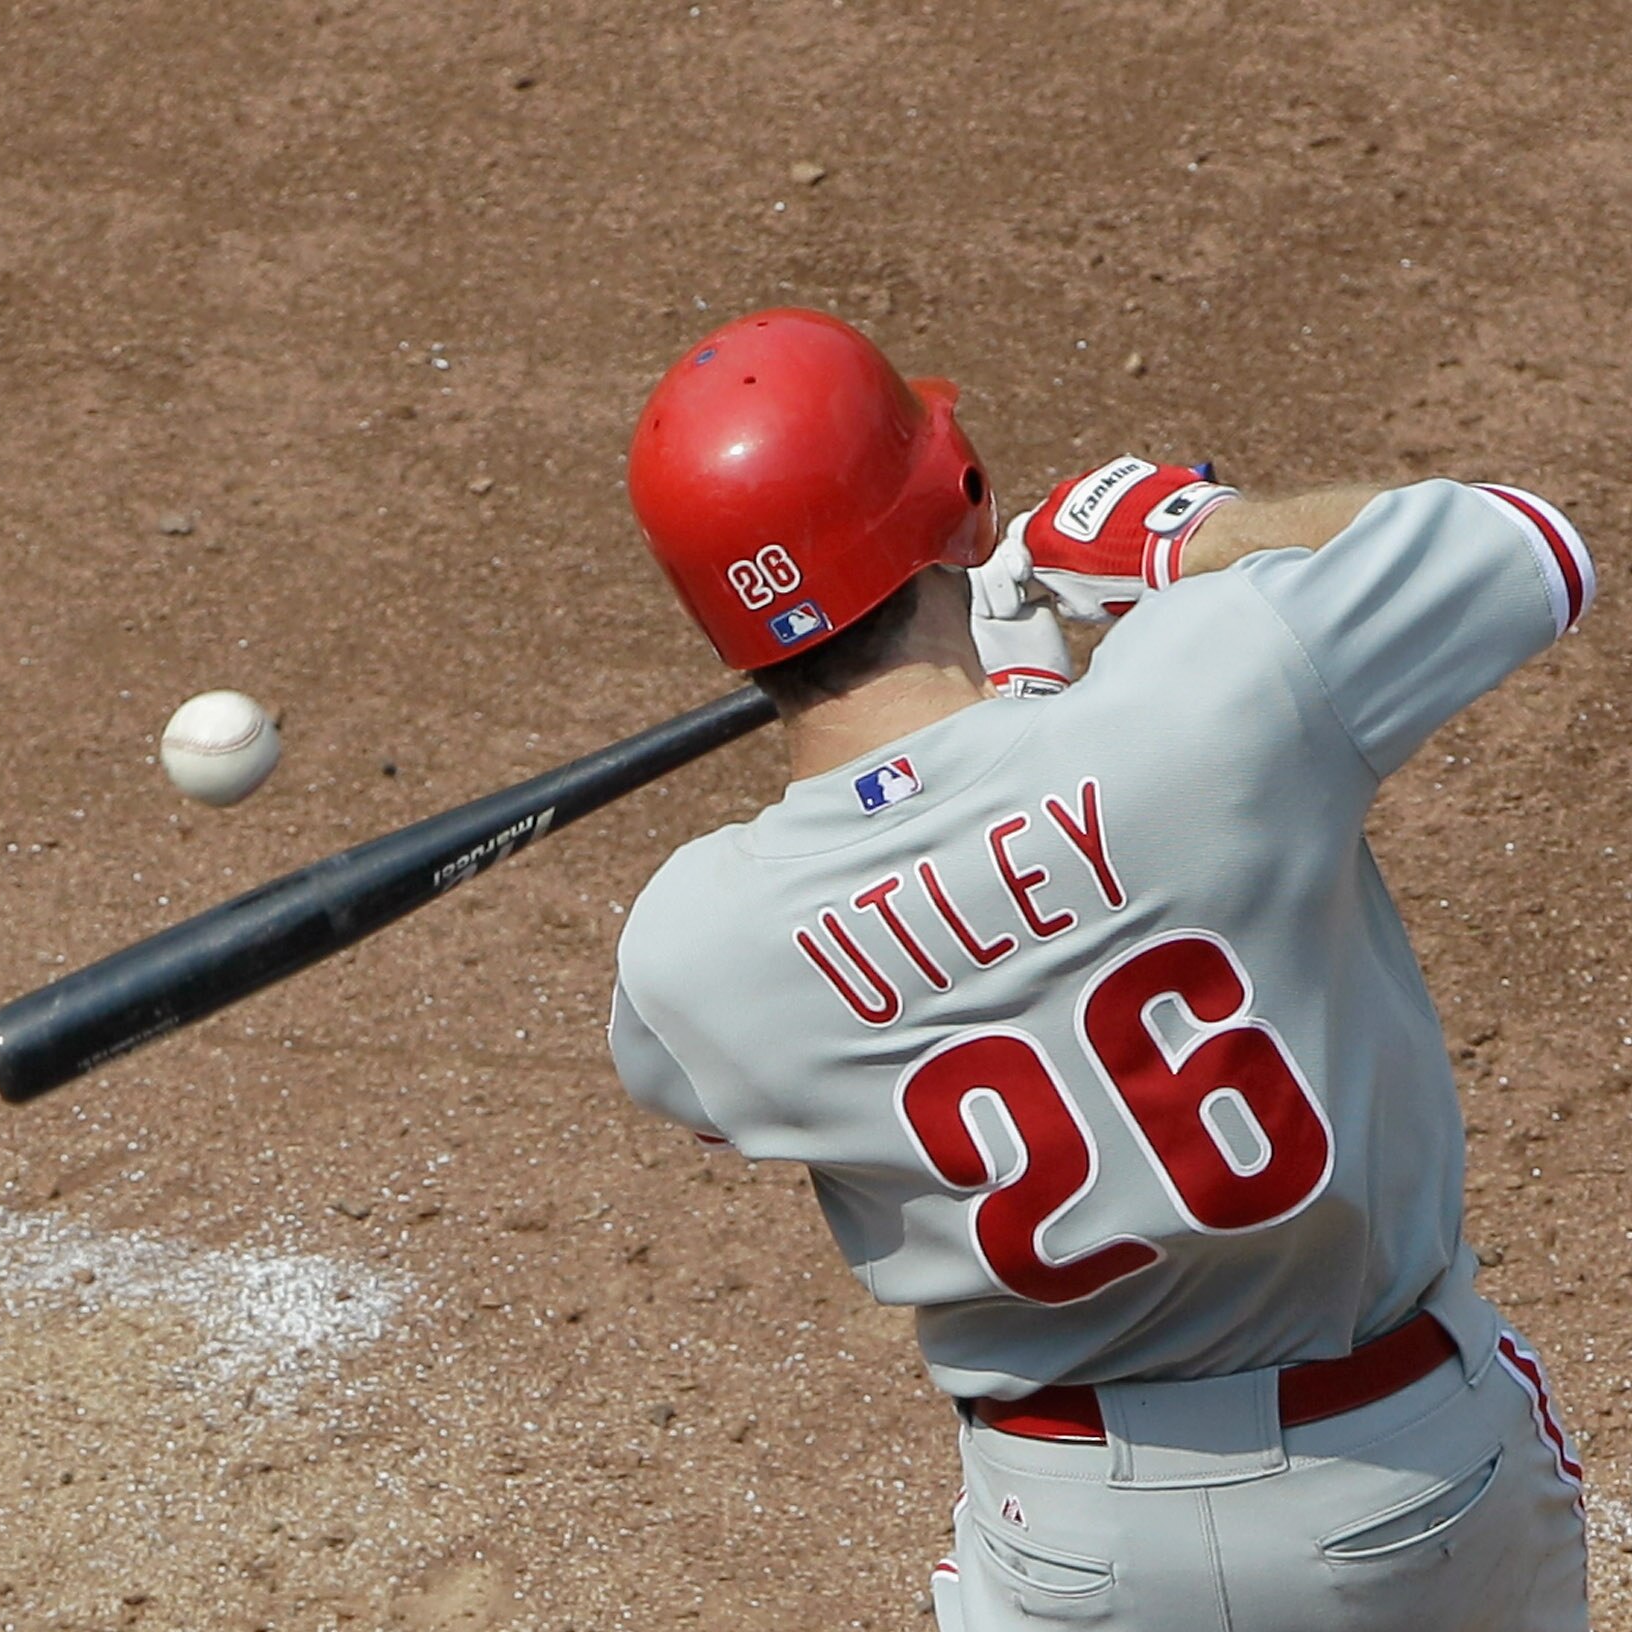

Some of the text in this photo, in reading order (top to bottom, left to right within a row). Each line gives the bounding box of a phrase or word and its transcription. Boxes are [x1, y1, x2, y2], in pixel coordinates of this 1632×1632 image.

[727, 544, 801, 610] 26
[792, 776, 1126, 1027] UTLEY
[894, 928, 1335, 1306] 26
